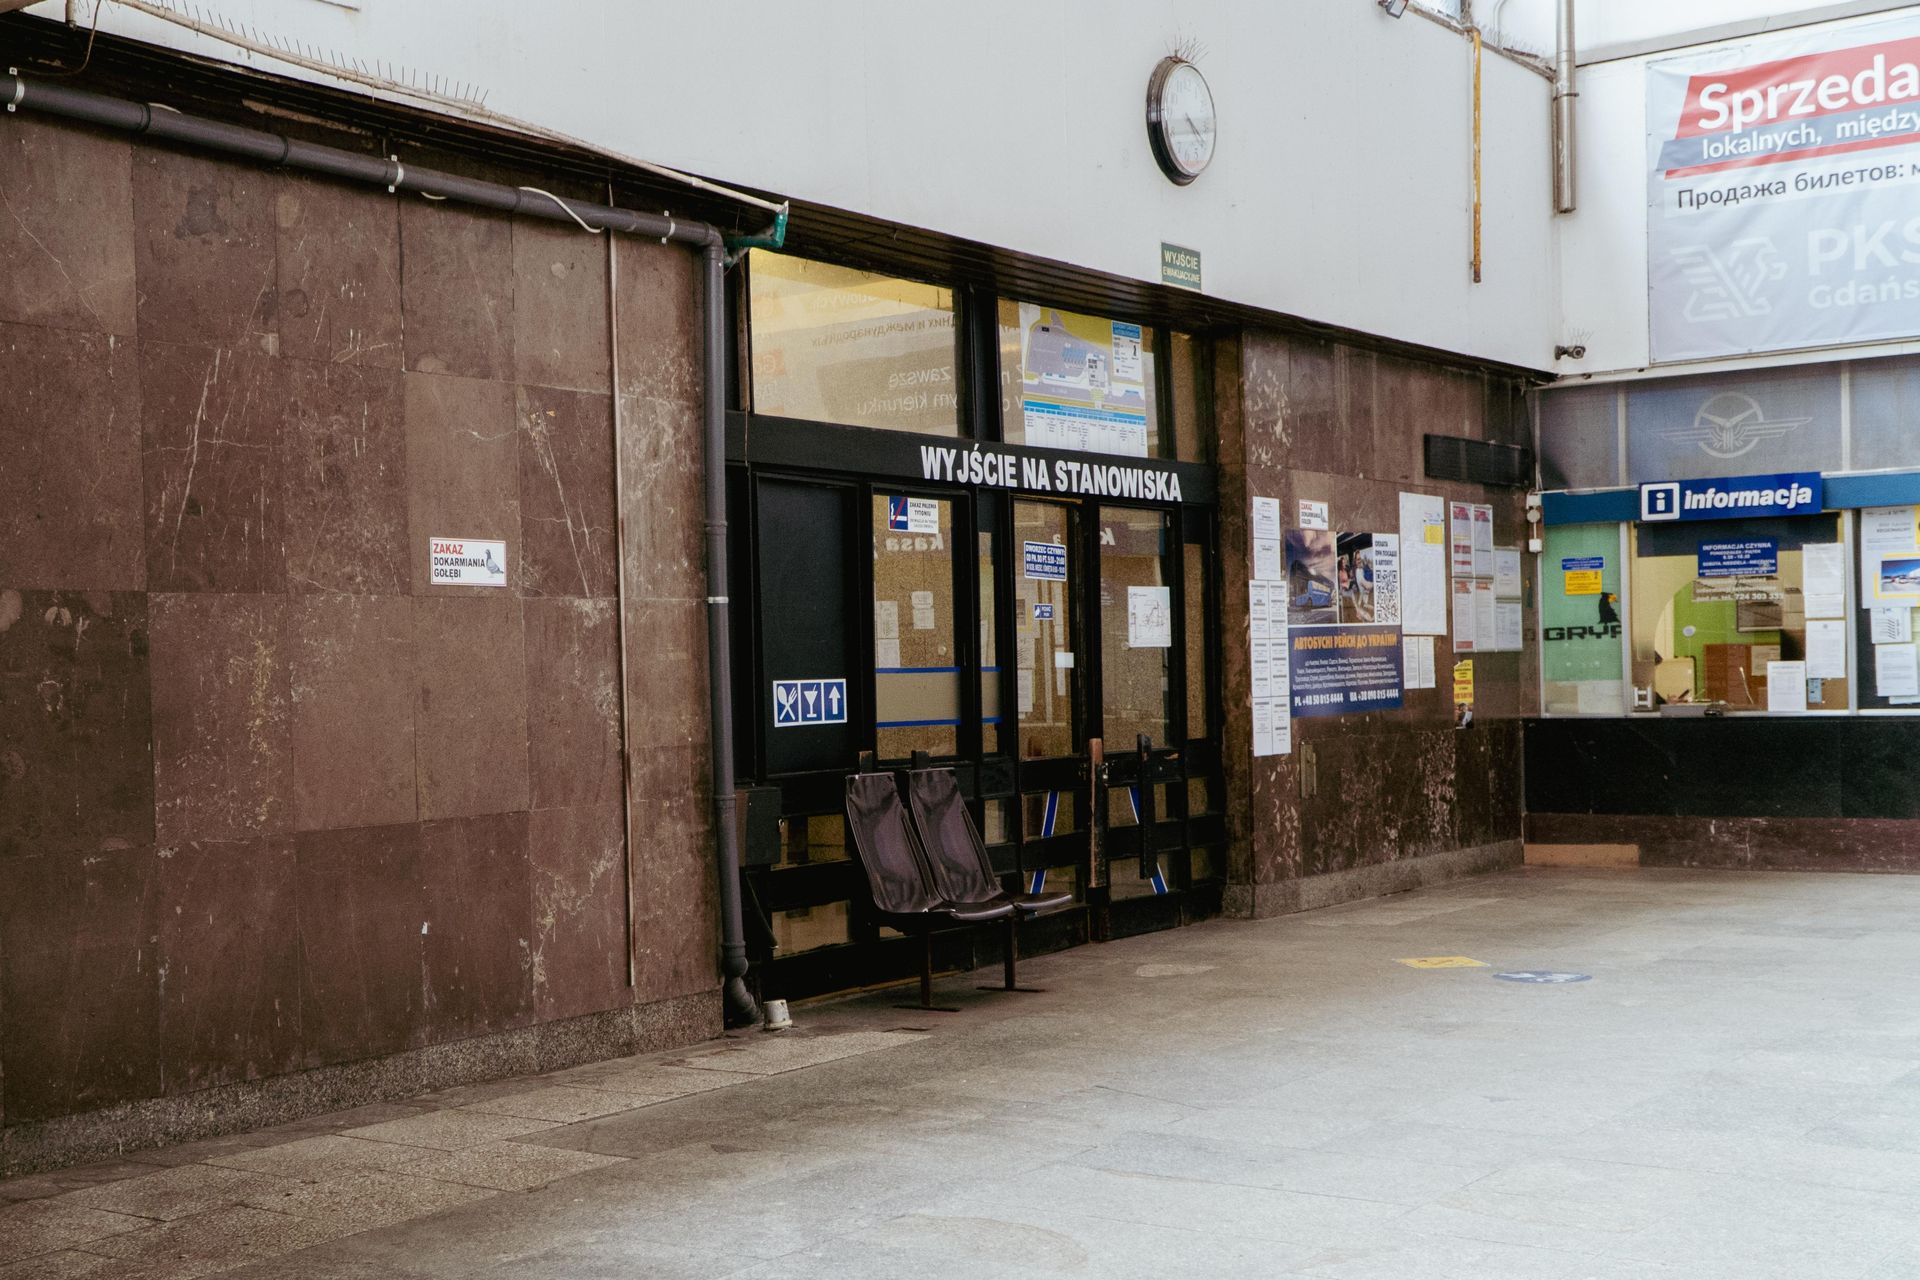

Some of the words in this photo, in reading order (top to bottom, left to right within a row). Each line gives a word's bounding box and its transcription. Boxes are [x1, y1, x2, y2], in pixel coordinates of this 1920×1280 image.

[1698, 54, 1920, 134] Sprzeda
[1702, 123, 1823, 160] lokalnych,
[1677, 180, 1787, 210] Продажа
[1794, 163, 1904, 192] билетов:
[1164, 250, 1199, 270] WYJŚCIE
[920, 444, 1018, 488] WYJŚCIE
[1022, 456, 1050, 491] NA
[1055, 460, 1183, 502] STANOWISKA
[433, 543, 464, 555] ZAKAZ
[1702, 543, 1744, 551] INFORMACJA
[433, 557, 486, 568] DOKARMIANIA
